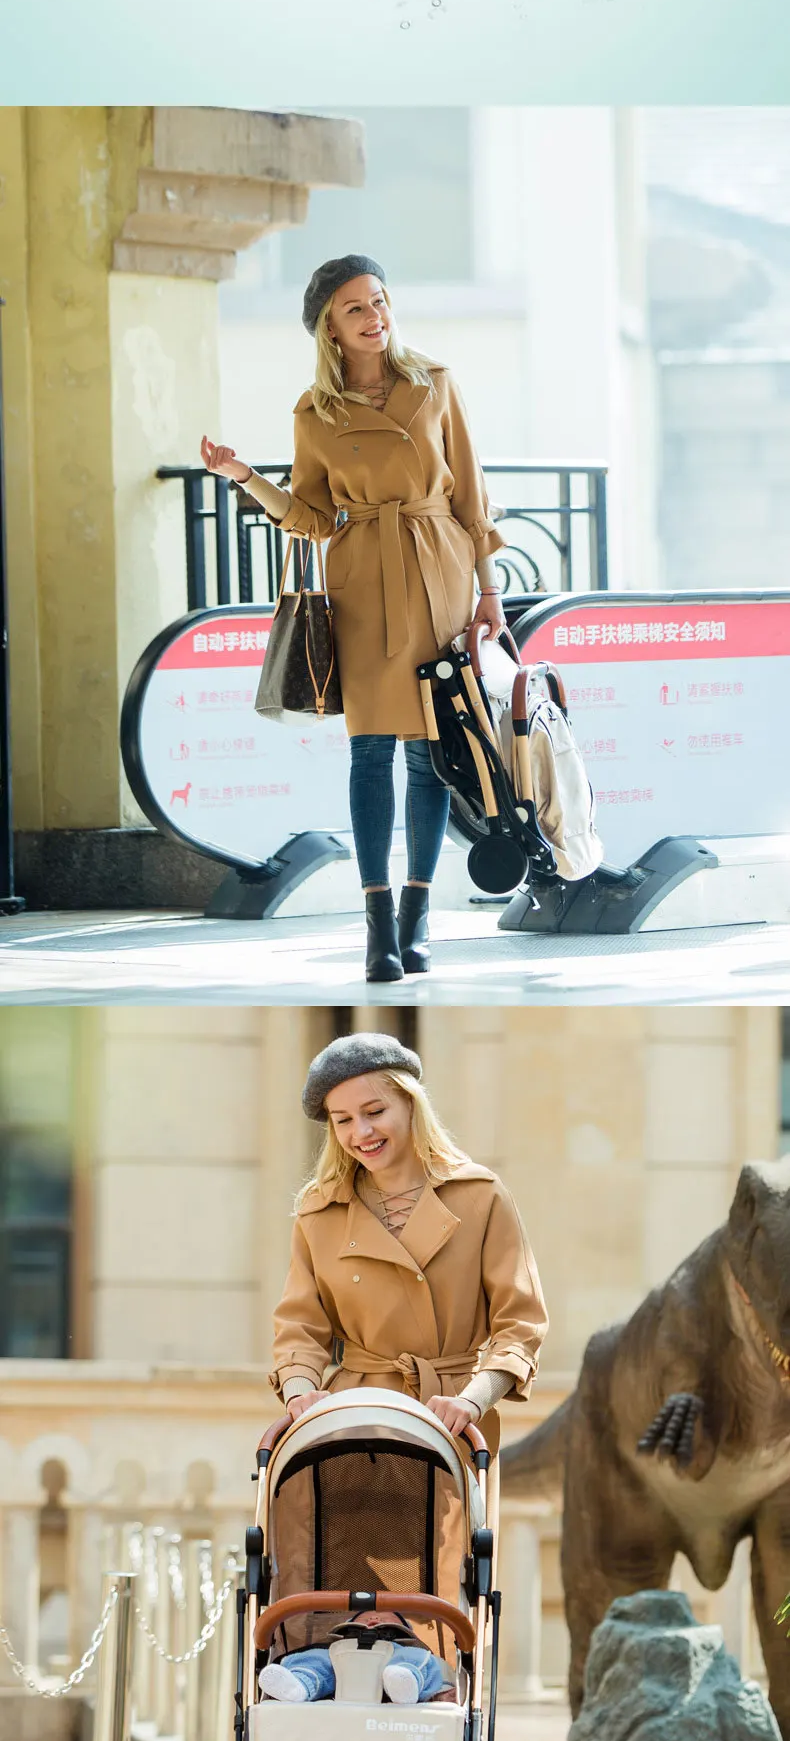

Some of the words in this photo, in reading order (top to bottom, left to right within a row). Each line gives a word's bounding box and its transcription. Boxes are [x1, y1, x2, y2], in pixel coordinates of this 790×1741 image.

[553, 621, 726, 646] 自动手扶梯乘梯安全须知
